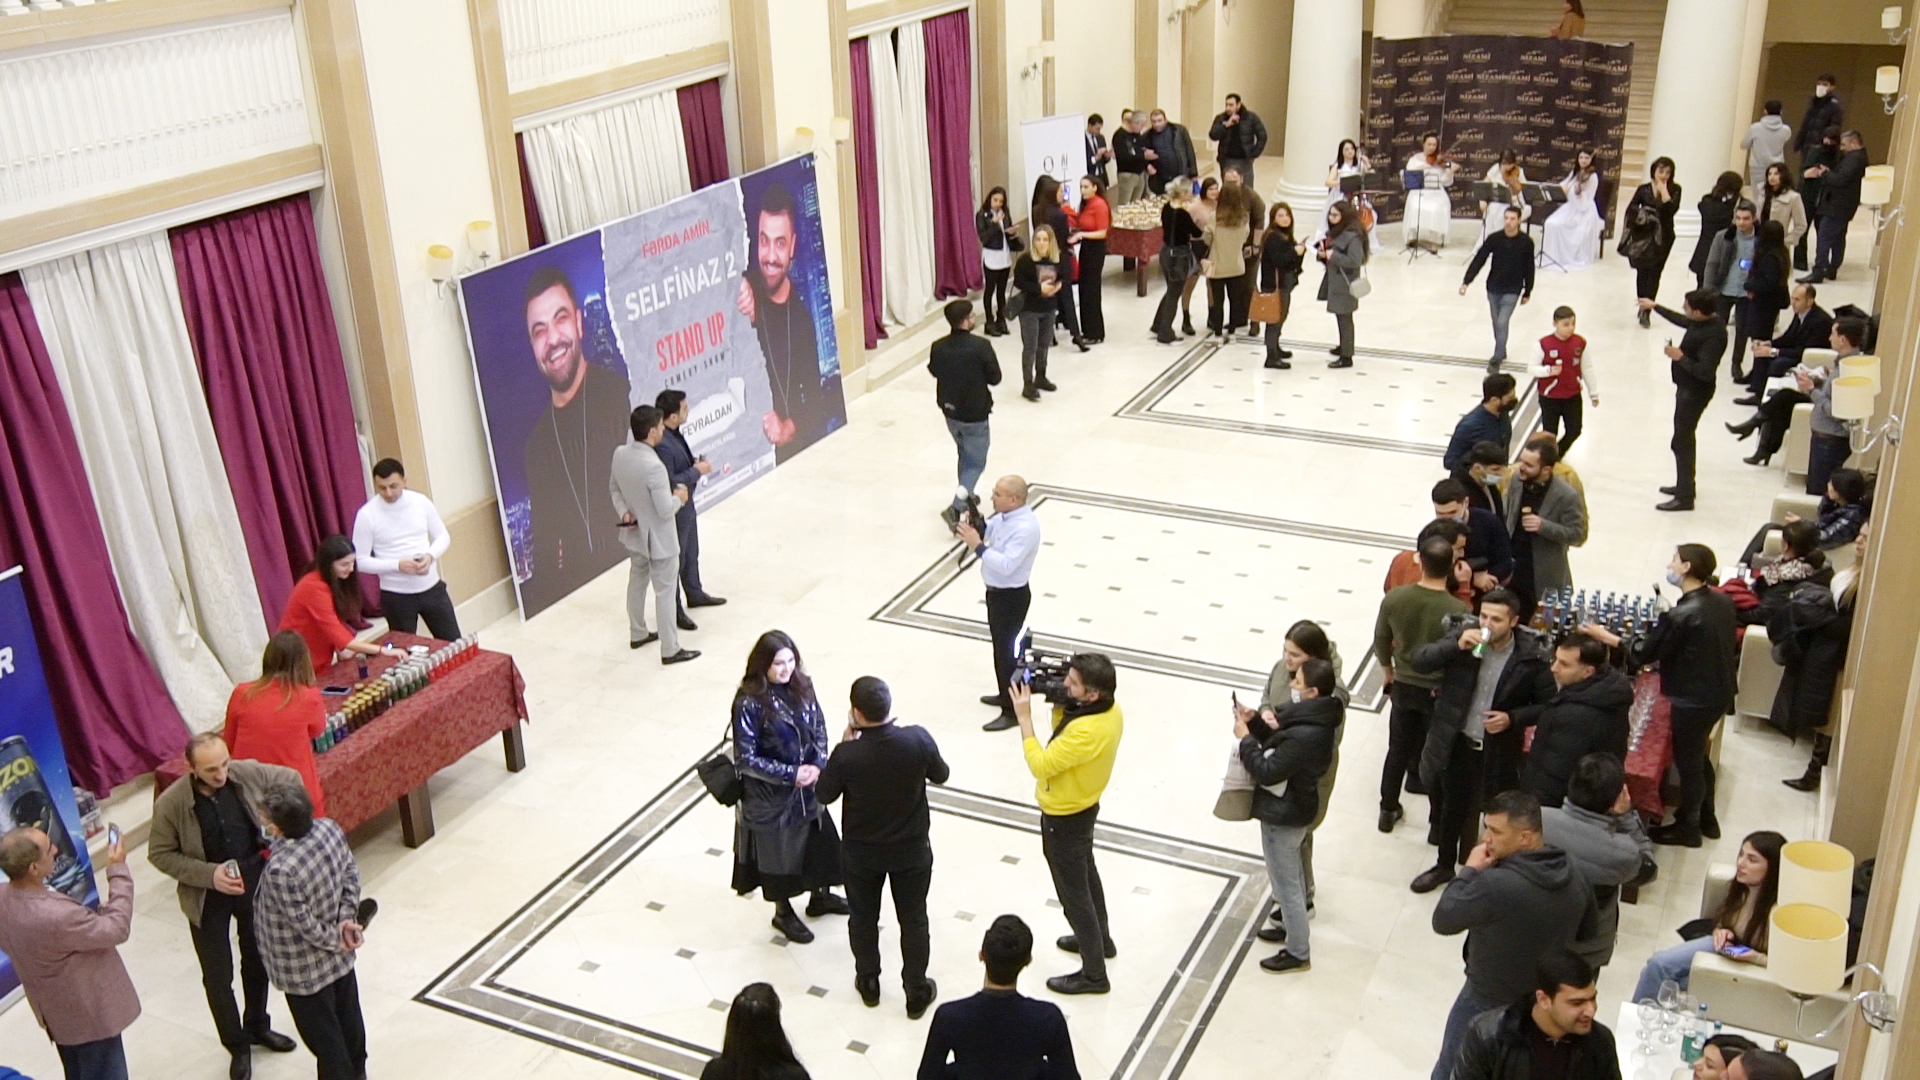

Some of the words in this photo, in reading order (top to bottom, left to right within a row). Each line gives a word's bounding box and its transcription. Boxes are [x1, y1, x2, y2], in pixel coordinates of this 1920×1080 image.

[642, 232, 681, 258] FƏRDA
[683, 219, 711, 243] AMİN
[625, 257, 722, 322] SELFİNAZ
[725, 251, 738, 280] 2
[656, 321, 705, 372] STAND
[707, 311, 725, 347] UP
[682, 402, 733, 437] FEVRALDAN
